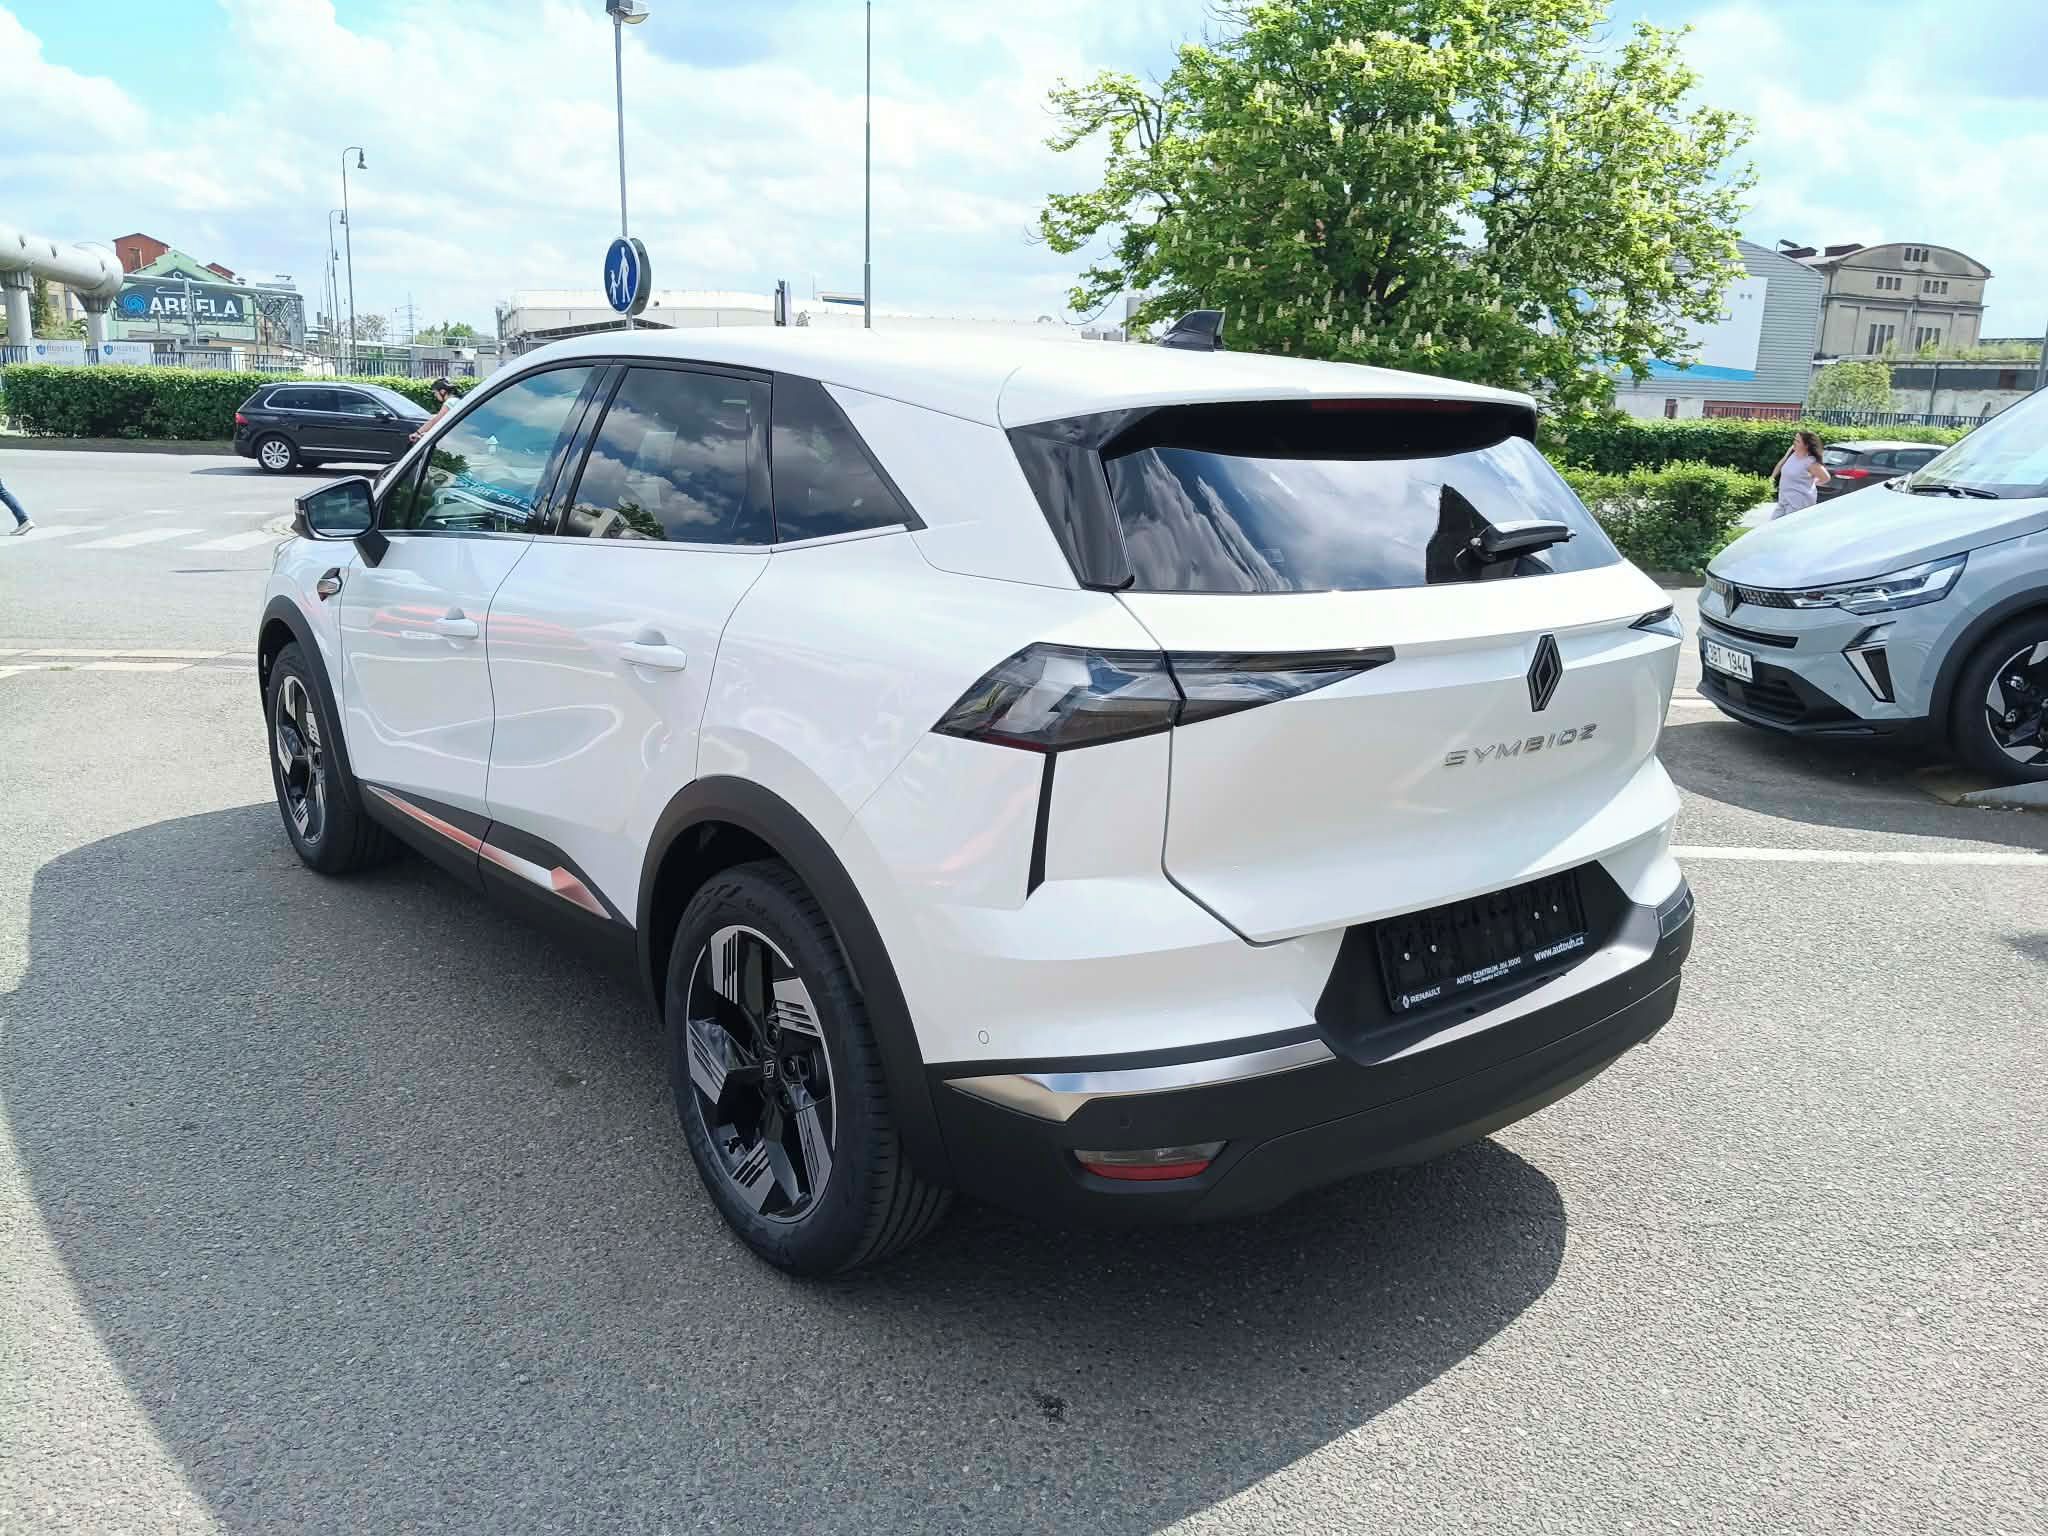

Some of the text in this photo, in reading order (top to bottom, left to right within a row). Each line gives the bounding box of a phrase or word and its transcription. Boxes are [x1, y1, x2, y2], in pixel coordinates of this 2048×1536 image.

[1728, 651, 1749, 673] 1944
[1444, 723, 1597, 766] SYMBIOZ
[1456, 974, 1472, 985] AUTO
[1472, 963, 1499, 979] CENTRUM
[1410, 986, 1441, 1003] RENAULT
